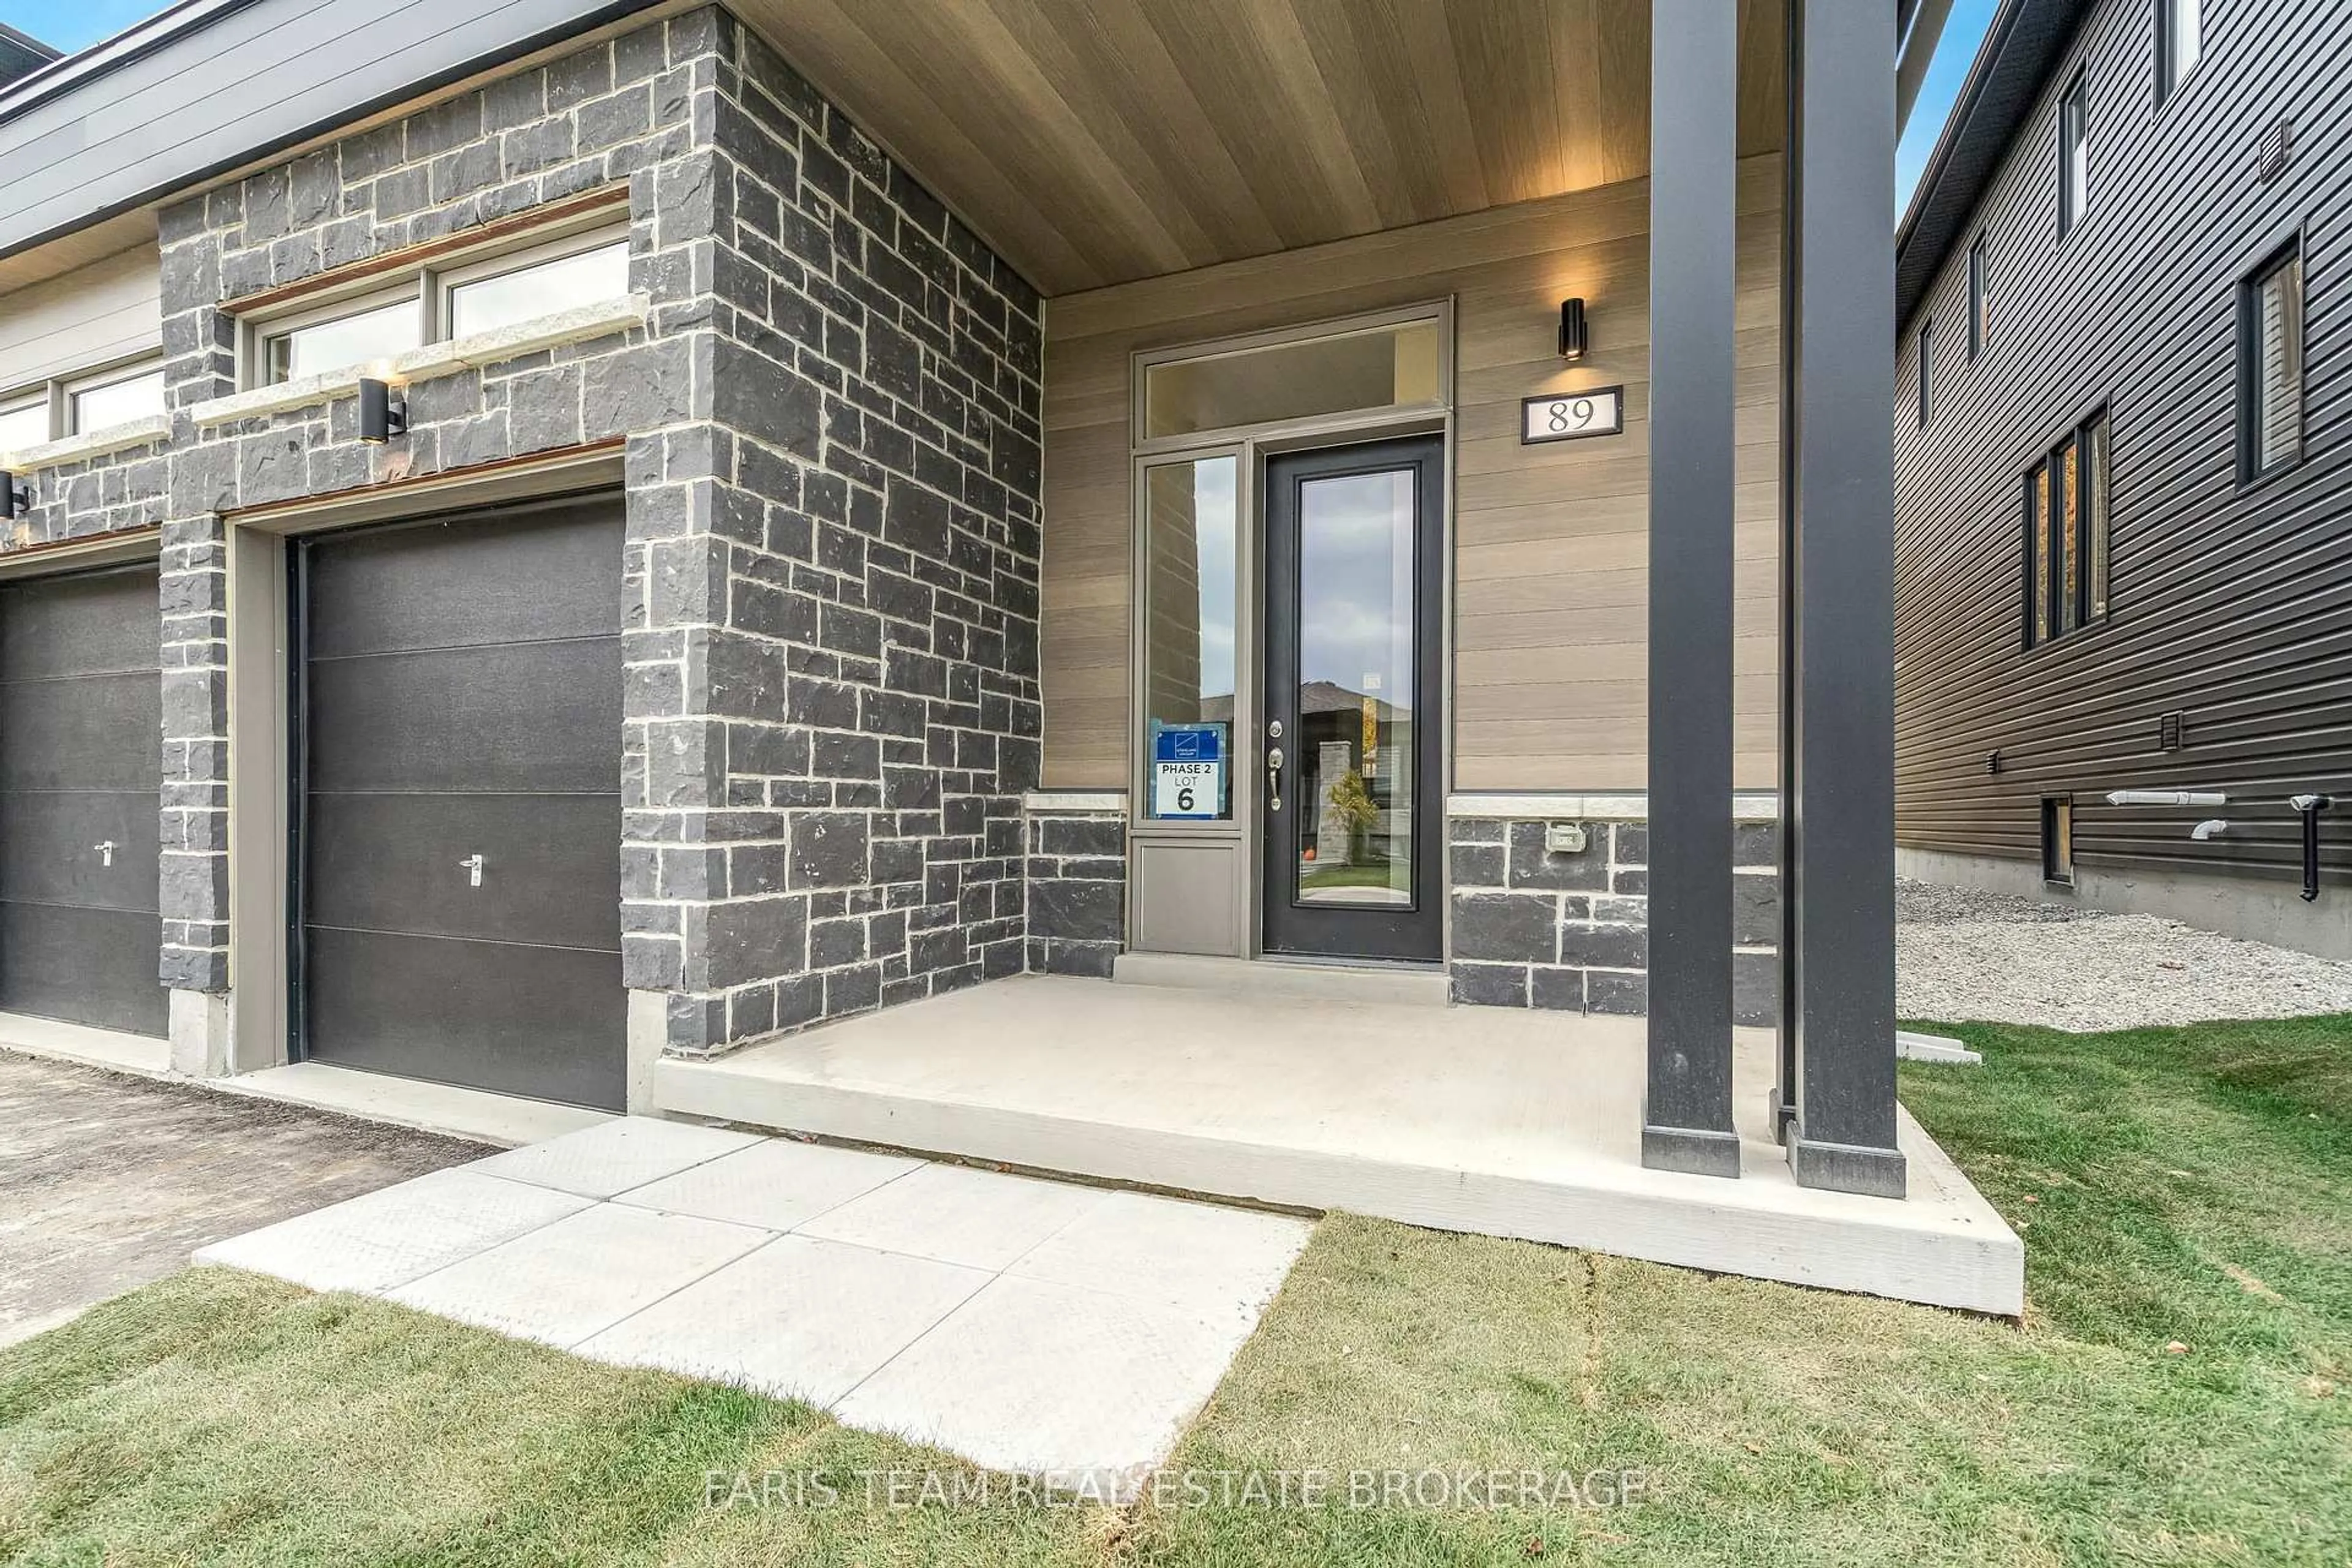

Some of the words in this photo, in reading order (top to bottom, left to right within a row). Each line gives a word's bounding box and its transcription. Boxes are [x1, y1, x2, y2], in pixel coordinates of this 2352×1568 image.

[1548, 399, 1594, 432] 89
[1163, 764, 1200, 774] PHASE
[1204, 764, 1212, 774] 2
[1175, 777, 1197, 786] LOT
[1177, 788, 1194, 811] 6
